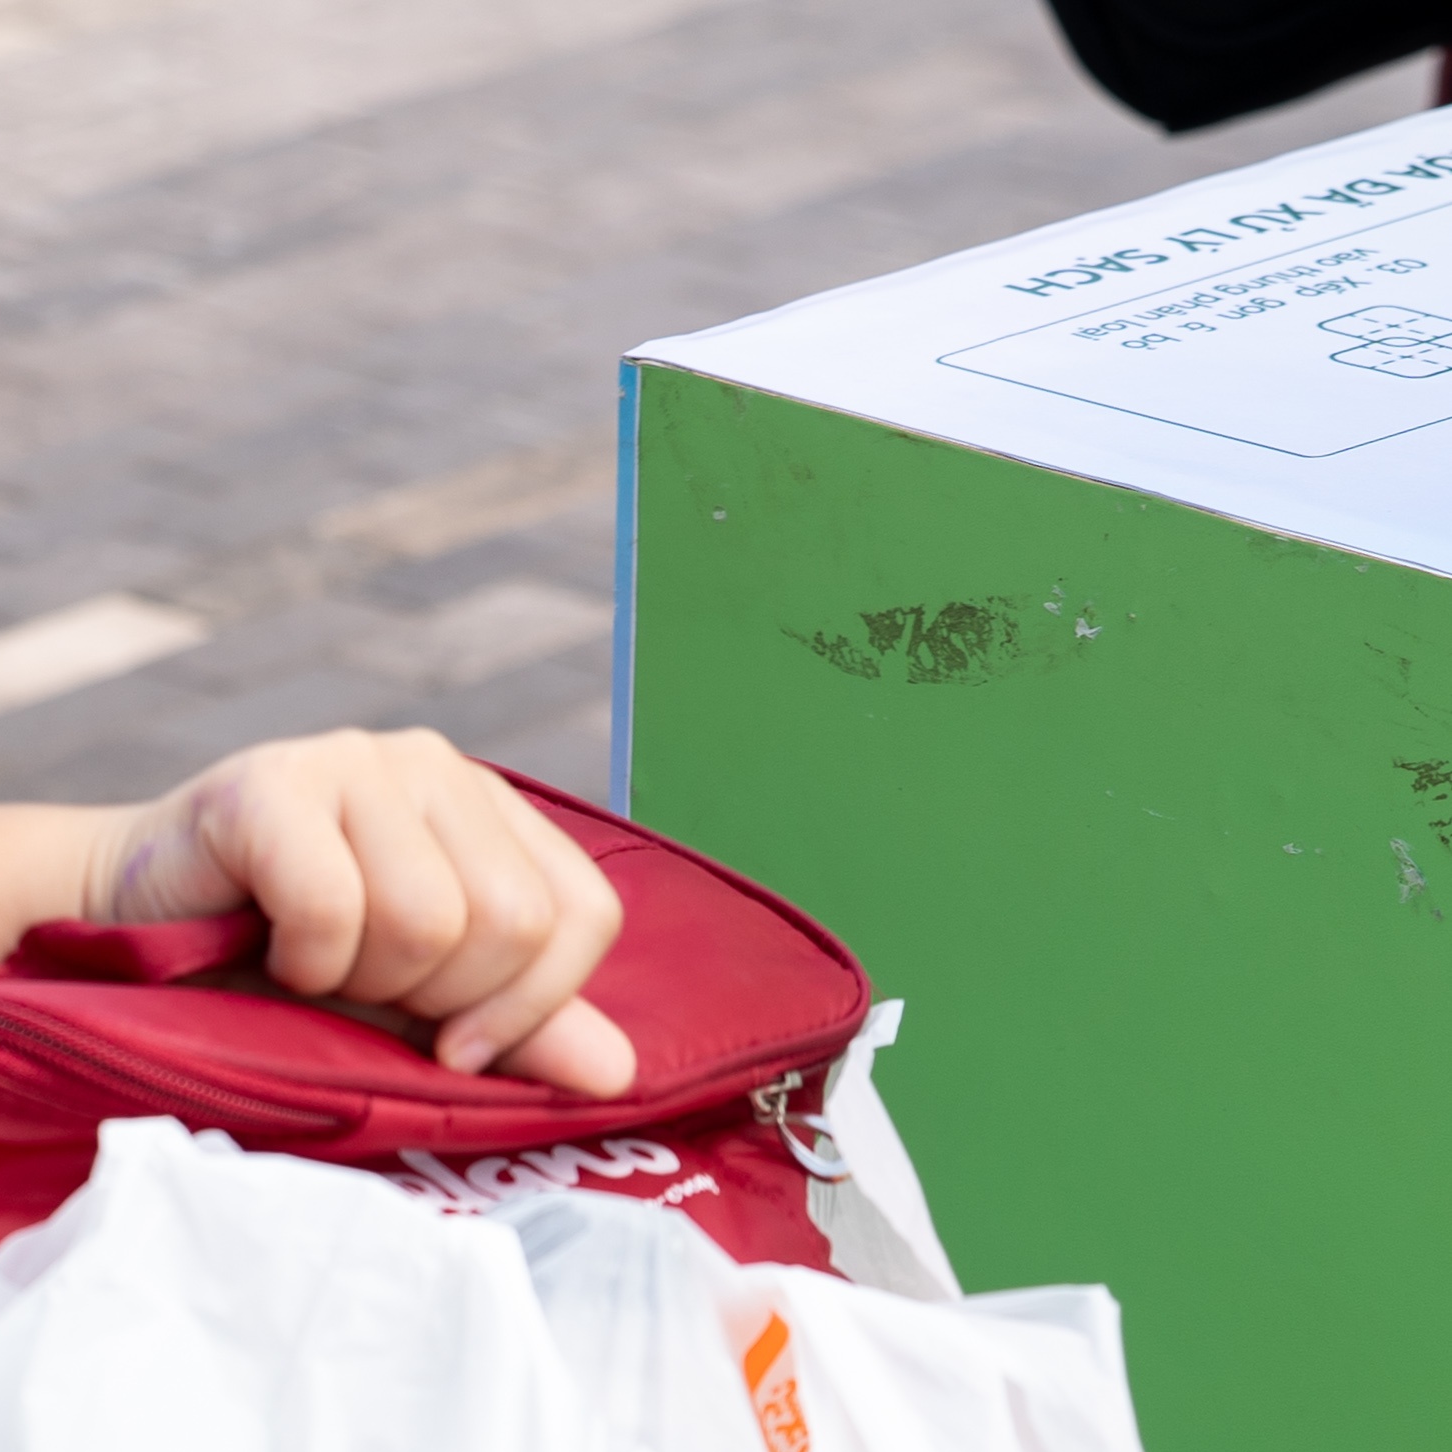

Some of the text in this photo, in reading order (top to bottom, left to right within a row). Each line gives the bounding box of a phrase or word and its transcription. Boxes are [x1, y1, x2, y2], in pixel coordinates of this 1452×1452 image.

[1303, 178, 1406, 207] ĐÃ
[1228, 202, 1328, 232] XỬ
[1164, 227, 1241, 253] LÝ
[1004, 249, 1170, 296] SẠCH
[1365, 257, 1428, 275] 03.
[1071, 248, 1380, 342] vào thùng phân loại
[1295, 276, 1371, 298] Xếp
[1217, 297, 1286, 321] gọn
[1121, 332, 1181, 350] bỏ
